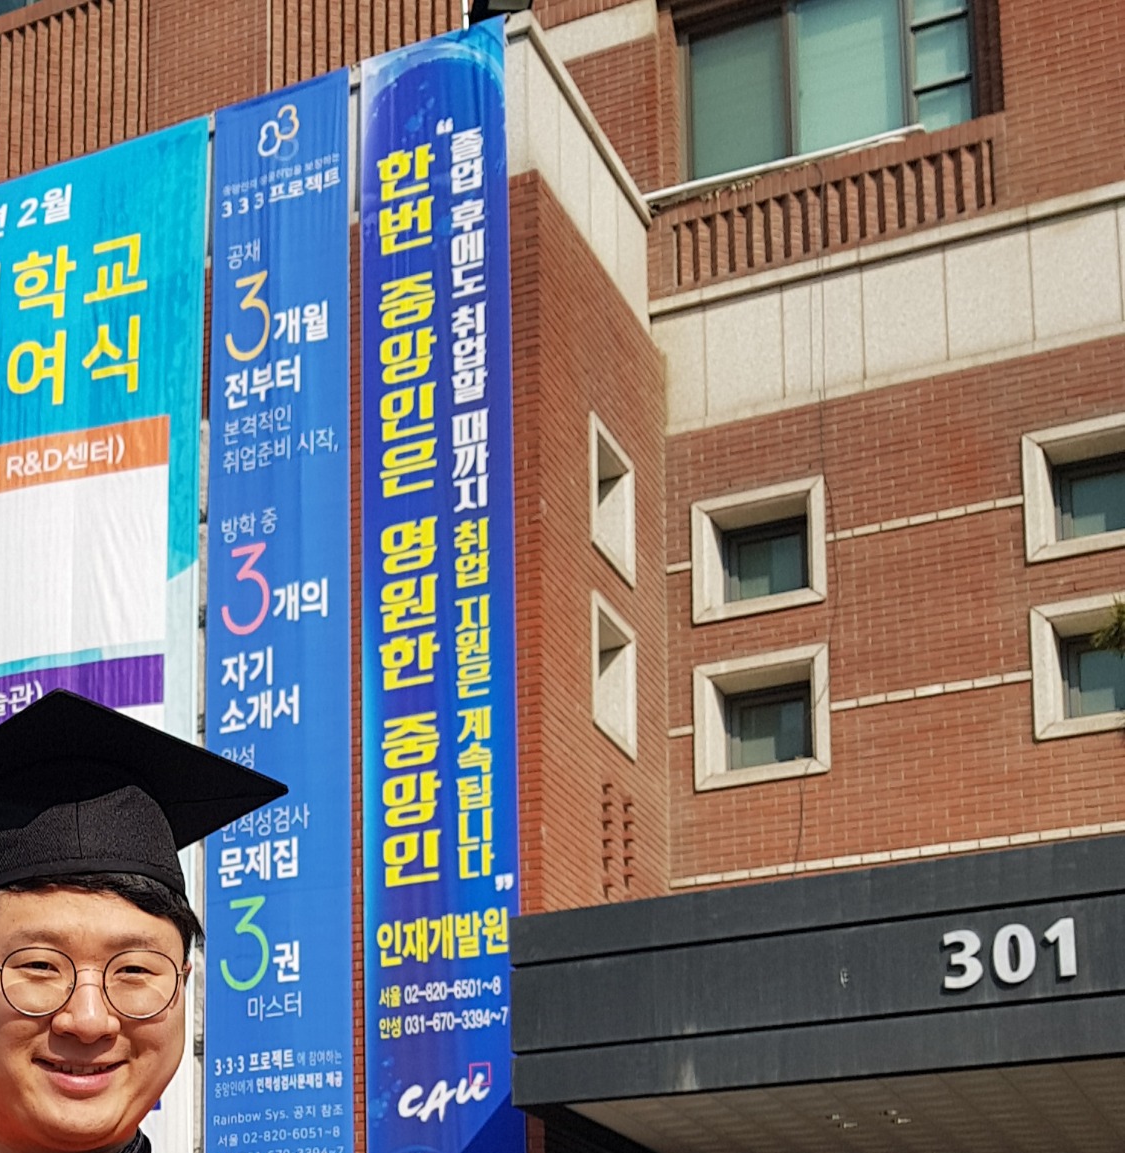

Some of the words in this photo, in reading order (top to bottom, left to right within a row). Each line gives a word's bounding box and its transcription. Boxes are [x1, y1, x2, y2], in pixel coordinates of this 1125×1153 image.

[17, 184, 73, 229] 2월
[268, 166, 341, 203] 프로젝트
[377, 143, 436, 256] 한번
[227, 239, 261, 269] 공채
[450, 198, 486, 299] 후에도
[225, 270, 270, 362] 3
[273, 300, 329, 344] 개월
[450, 301, 489, 405] 취업할
[224, 355, 302, 411] 전부터
[378, 271, 438, 499] 중앙인은
[223, 404, 292, 446] 본격적인
[6, 438, 125, 479] R&D센터)
[223, 438, 291, 475] 취업준비
[298, 427, 339, 454] 시작,
[451, 407, 489, 513] 때까지
[221, 512, 257, 544] 방학
[260, 507, 278, 534] 중
[453, 516, 489, 589] 취업
[221, 541, 270, 636] 3
[272, 577, 329, 622] 개의
[378, 514, 440, 692] 영원한
[221, 646, 273, 691] 자기
[454, 593, 491, 699] 지원은
[219, 684, 300, 735] 소개서
[381, 712, 441, 888] 중앙인
[217, 836, 299, 888] 문제집
[220, 896, 270, 991] 3
[272, 940, 300, 983] 권
[376, 907, 509, 967] 인재개발원
[943, 917, 1077, 990] 301
[247, 991, 303, 1022] 마스터
[379, 985, 402, 1008] 서울
[404, 975, 501, 1004] 02-820-6501~8
[379, 1016, 402, 1040] 안성
[404, 1007, 508, 1035] 031-670-3394~7
[248, 1048, 294, 1072] 프로젝트
[309, 1049, 342, 1066] 참여하는
[215, 1078, 254, 1098] 중앙인에게
[213, 1110, 261, 1127] Rainbow
[265, 1107, 289, 1123] Sys.
[293, 1104, 316, 1120] 공지
[321, 1103, 344, 1118] 참조
[217, 1133, 238, 1148] 서울
[243, 1125, 340, 1145] 02-820-6051~8
